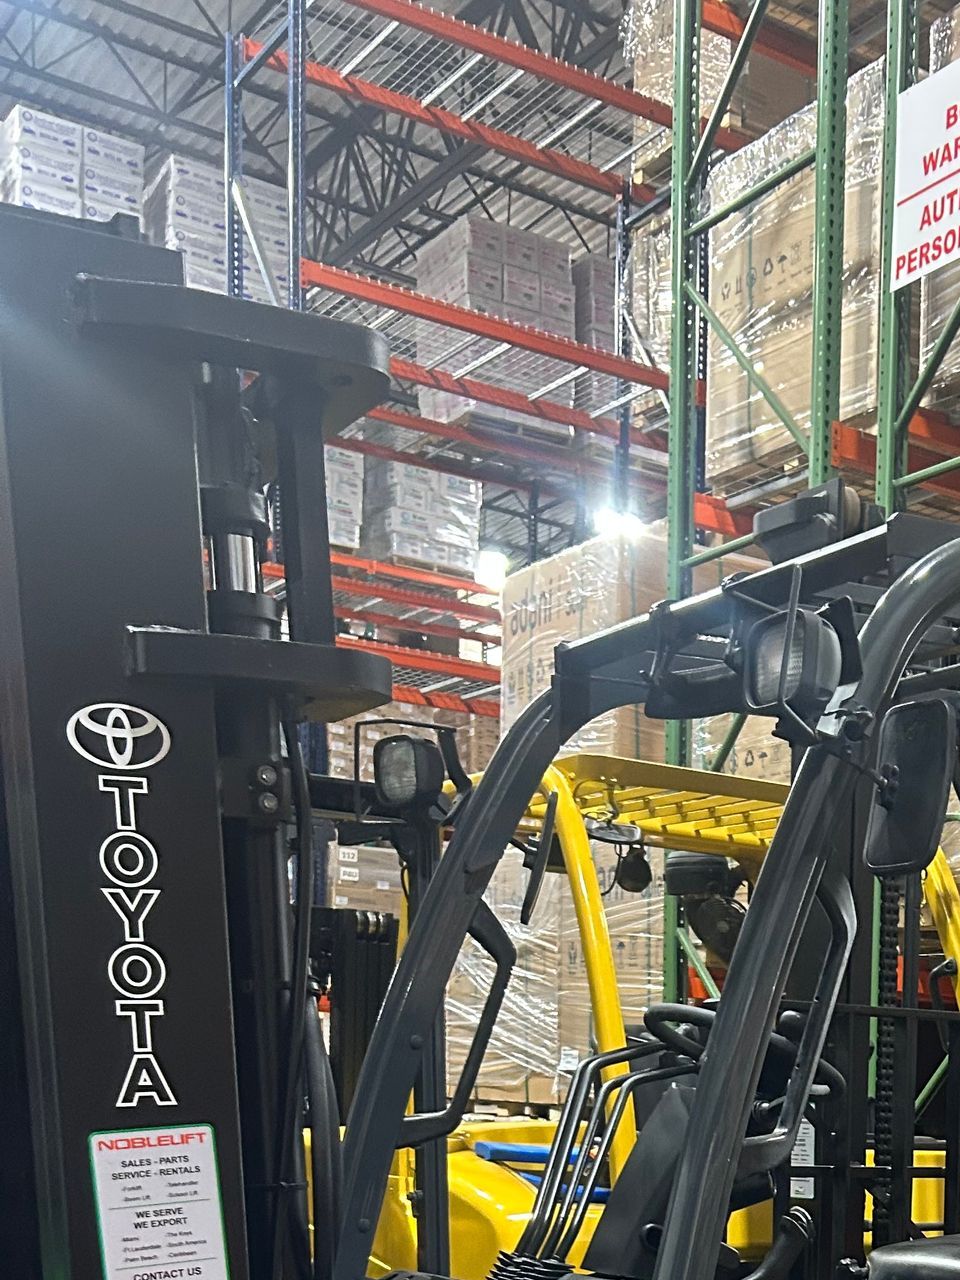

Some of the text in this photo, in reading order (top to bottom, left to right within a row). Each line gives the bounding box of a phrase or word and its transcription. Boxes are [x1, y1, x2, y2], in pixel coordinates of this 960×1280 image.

[98, 774, 178, 1108] TOYOTA
[98, 1132, 206, 1151] NOBLELIFT
[121, 1158, 151, 1168] SALES
[159, 1155, 189, 1164] PARTS
[112, 1170, 151, 1180] SERVICE
[159, 1166, 200, 1176] RENTALS
[135, 1207, 183, 1219] WE SERVE
[133, 1216, 188, 1230] WE EXPORT
[187, 1266, 202, 1276] US
